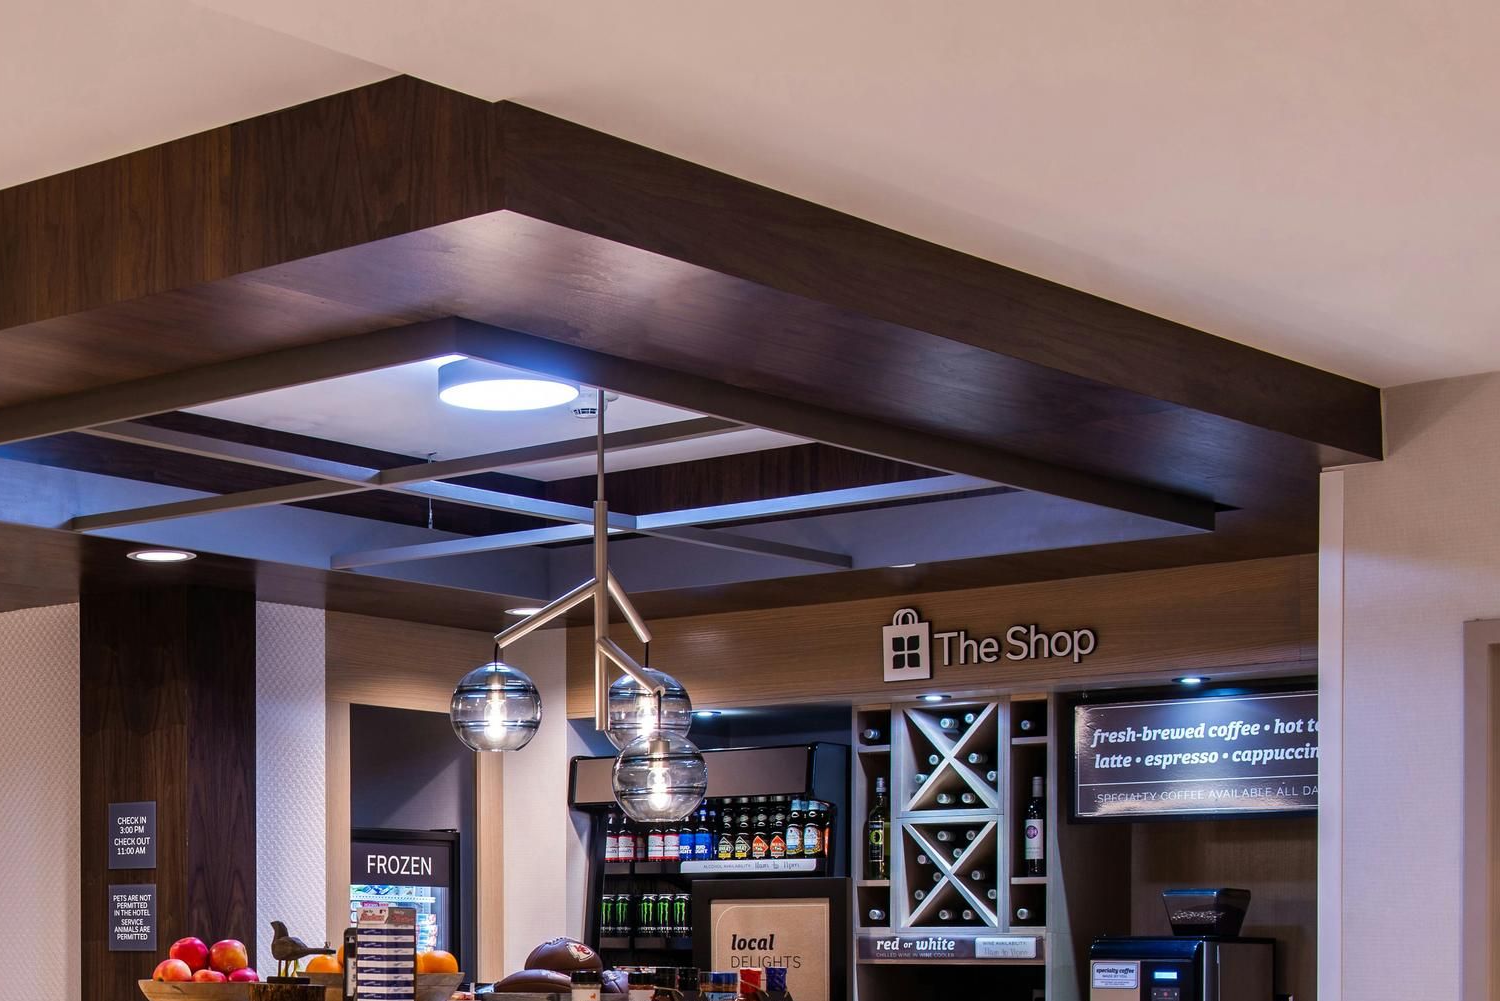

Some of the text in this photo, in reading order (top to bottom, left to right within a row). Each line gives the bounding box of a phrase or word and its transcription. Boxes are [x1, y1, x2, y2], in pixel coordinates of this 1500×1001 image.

[933, 624, 1095, 666] The Shop
[1090, 722, 1205, 748] fresh-brewed
[1208, 720, 1260, 741] coffee
[1273, 718, 1303, 734] hot
[1094, 753, 1132, 769] latte
[1144, 751, 1218, 769] espresso
[1096, 791, 1157, 804] SPECIALTY
[1160, 789, 1205, 801] COFFEE
[1209, 787, 1272, 799] AVAILABLE
[1276, 786, 1298, 797] ALL
[117, 816, 147, 825] CHECK IN
[119, 825, 144, 834] 3:00 PM
[114, 837, 150, 846] CHECK OUT
[117, 847, 134, 855] 11:00
[367, 854, 432, 875] FROZEN
[731, 934, 774, 950] local
[876, 937, 900, 951] red
[916, 937, 956, 951] white
[731, 956, 801, 968] DELIGHTS
[1119, 967, 1135, 975] coffee
